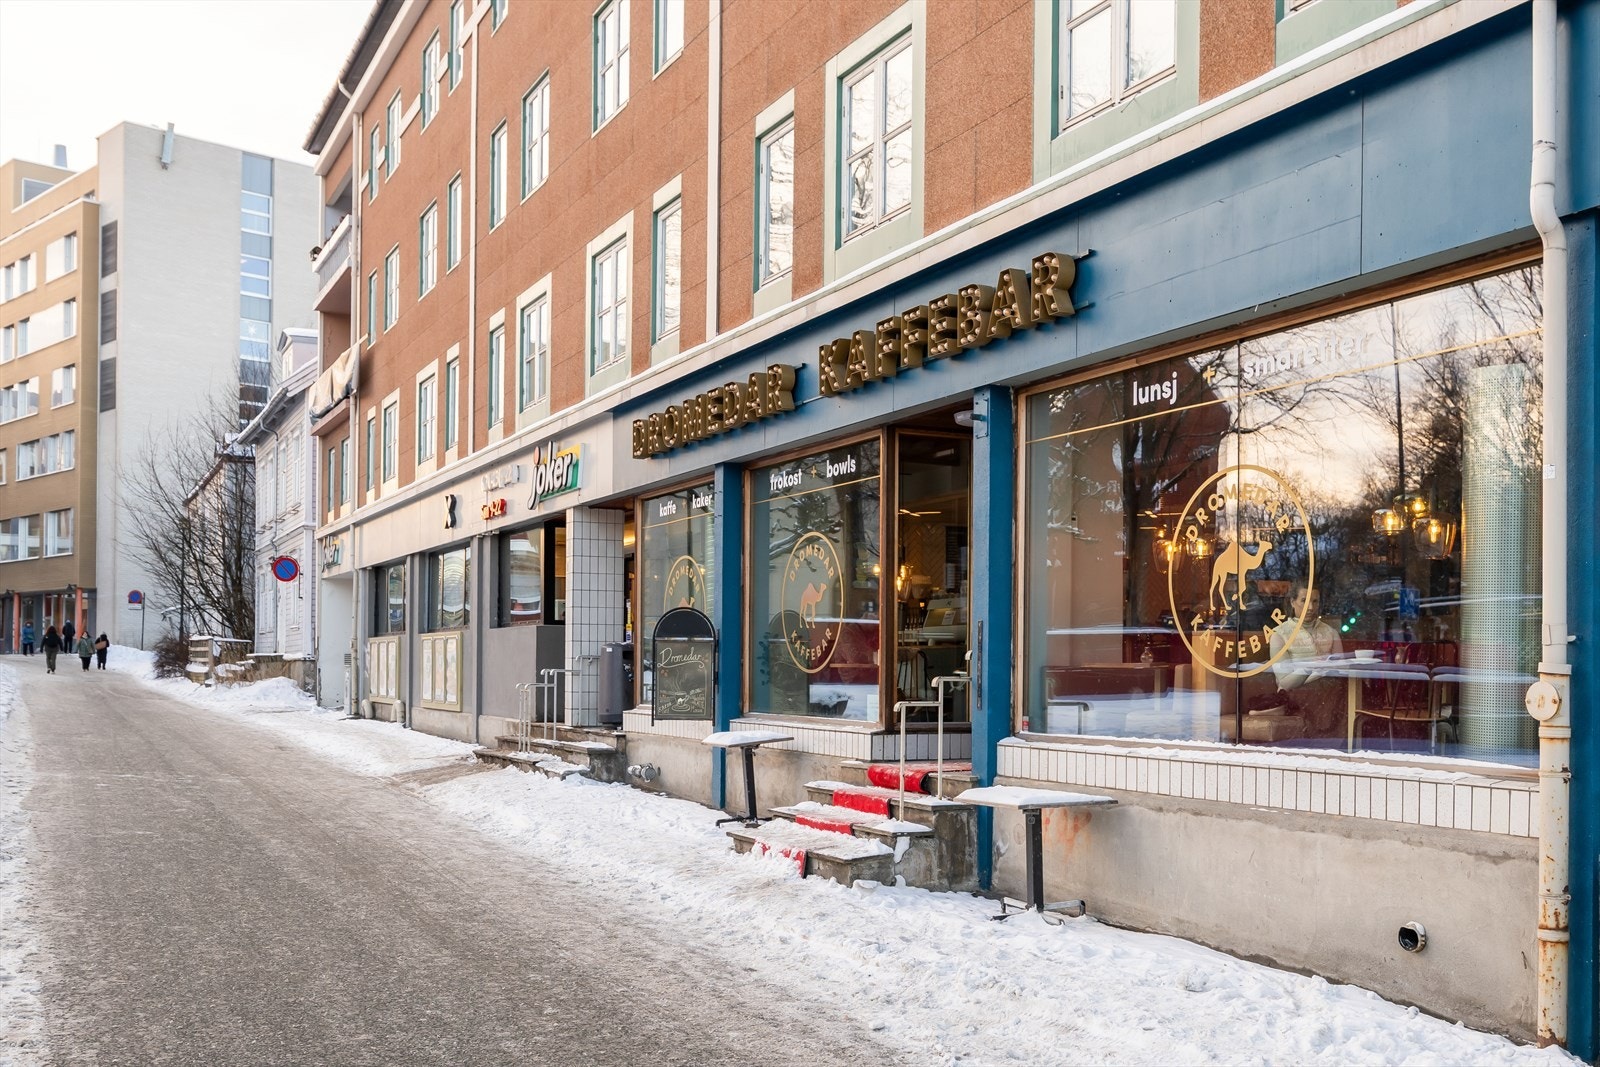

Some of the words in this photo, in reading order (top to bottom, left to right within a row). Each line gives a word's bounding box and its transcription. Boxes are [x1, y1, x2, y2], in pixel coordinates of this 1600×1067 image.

[632, 364, 796, 459] DROMEDAR
[819, 252, 1075, 396] KAFFEBAR
[1133, 372, 1178, 405] lunsj
[528, 441, 576, 510] joker
[770, 468, 802, 490] frokost
[826, 454, 856, 478] bowls
[659, 500, 677, 517] kaffe
[692, 492, 712, 509] kaker
[1185, 483, 1290, 542] DROMEDAR
[669, 565, 700, 596] DROMEDAR
[789, 544, 834, 582] DROMEDAR
[791, 627, 832, 661] KAFFEBAR
[1191, 607, 1286, 658] KAFFEBAR
[657, 646, 703, 667] Dromedar
